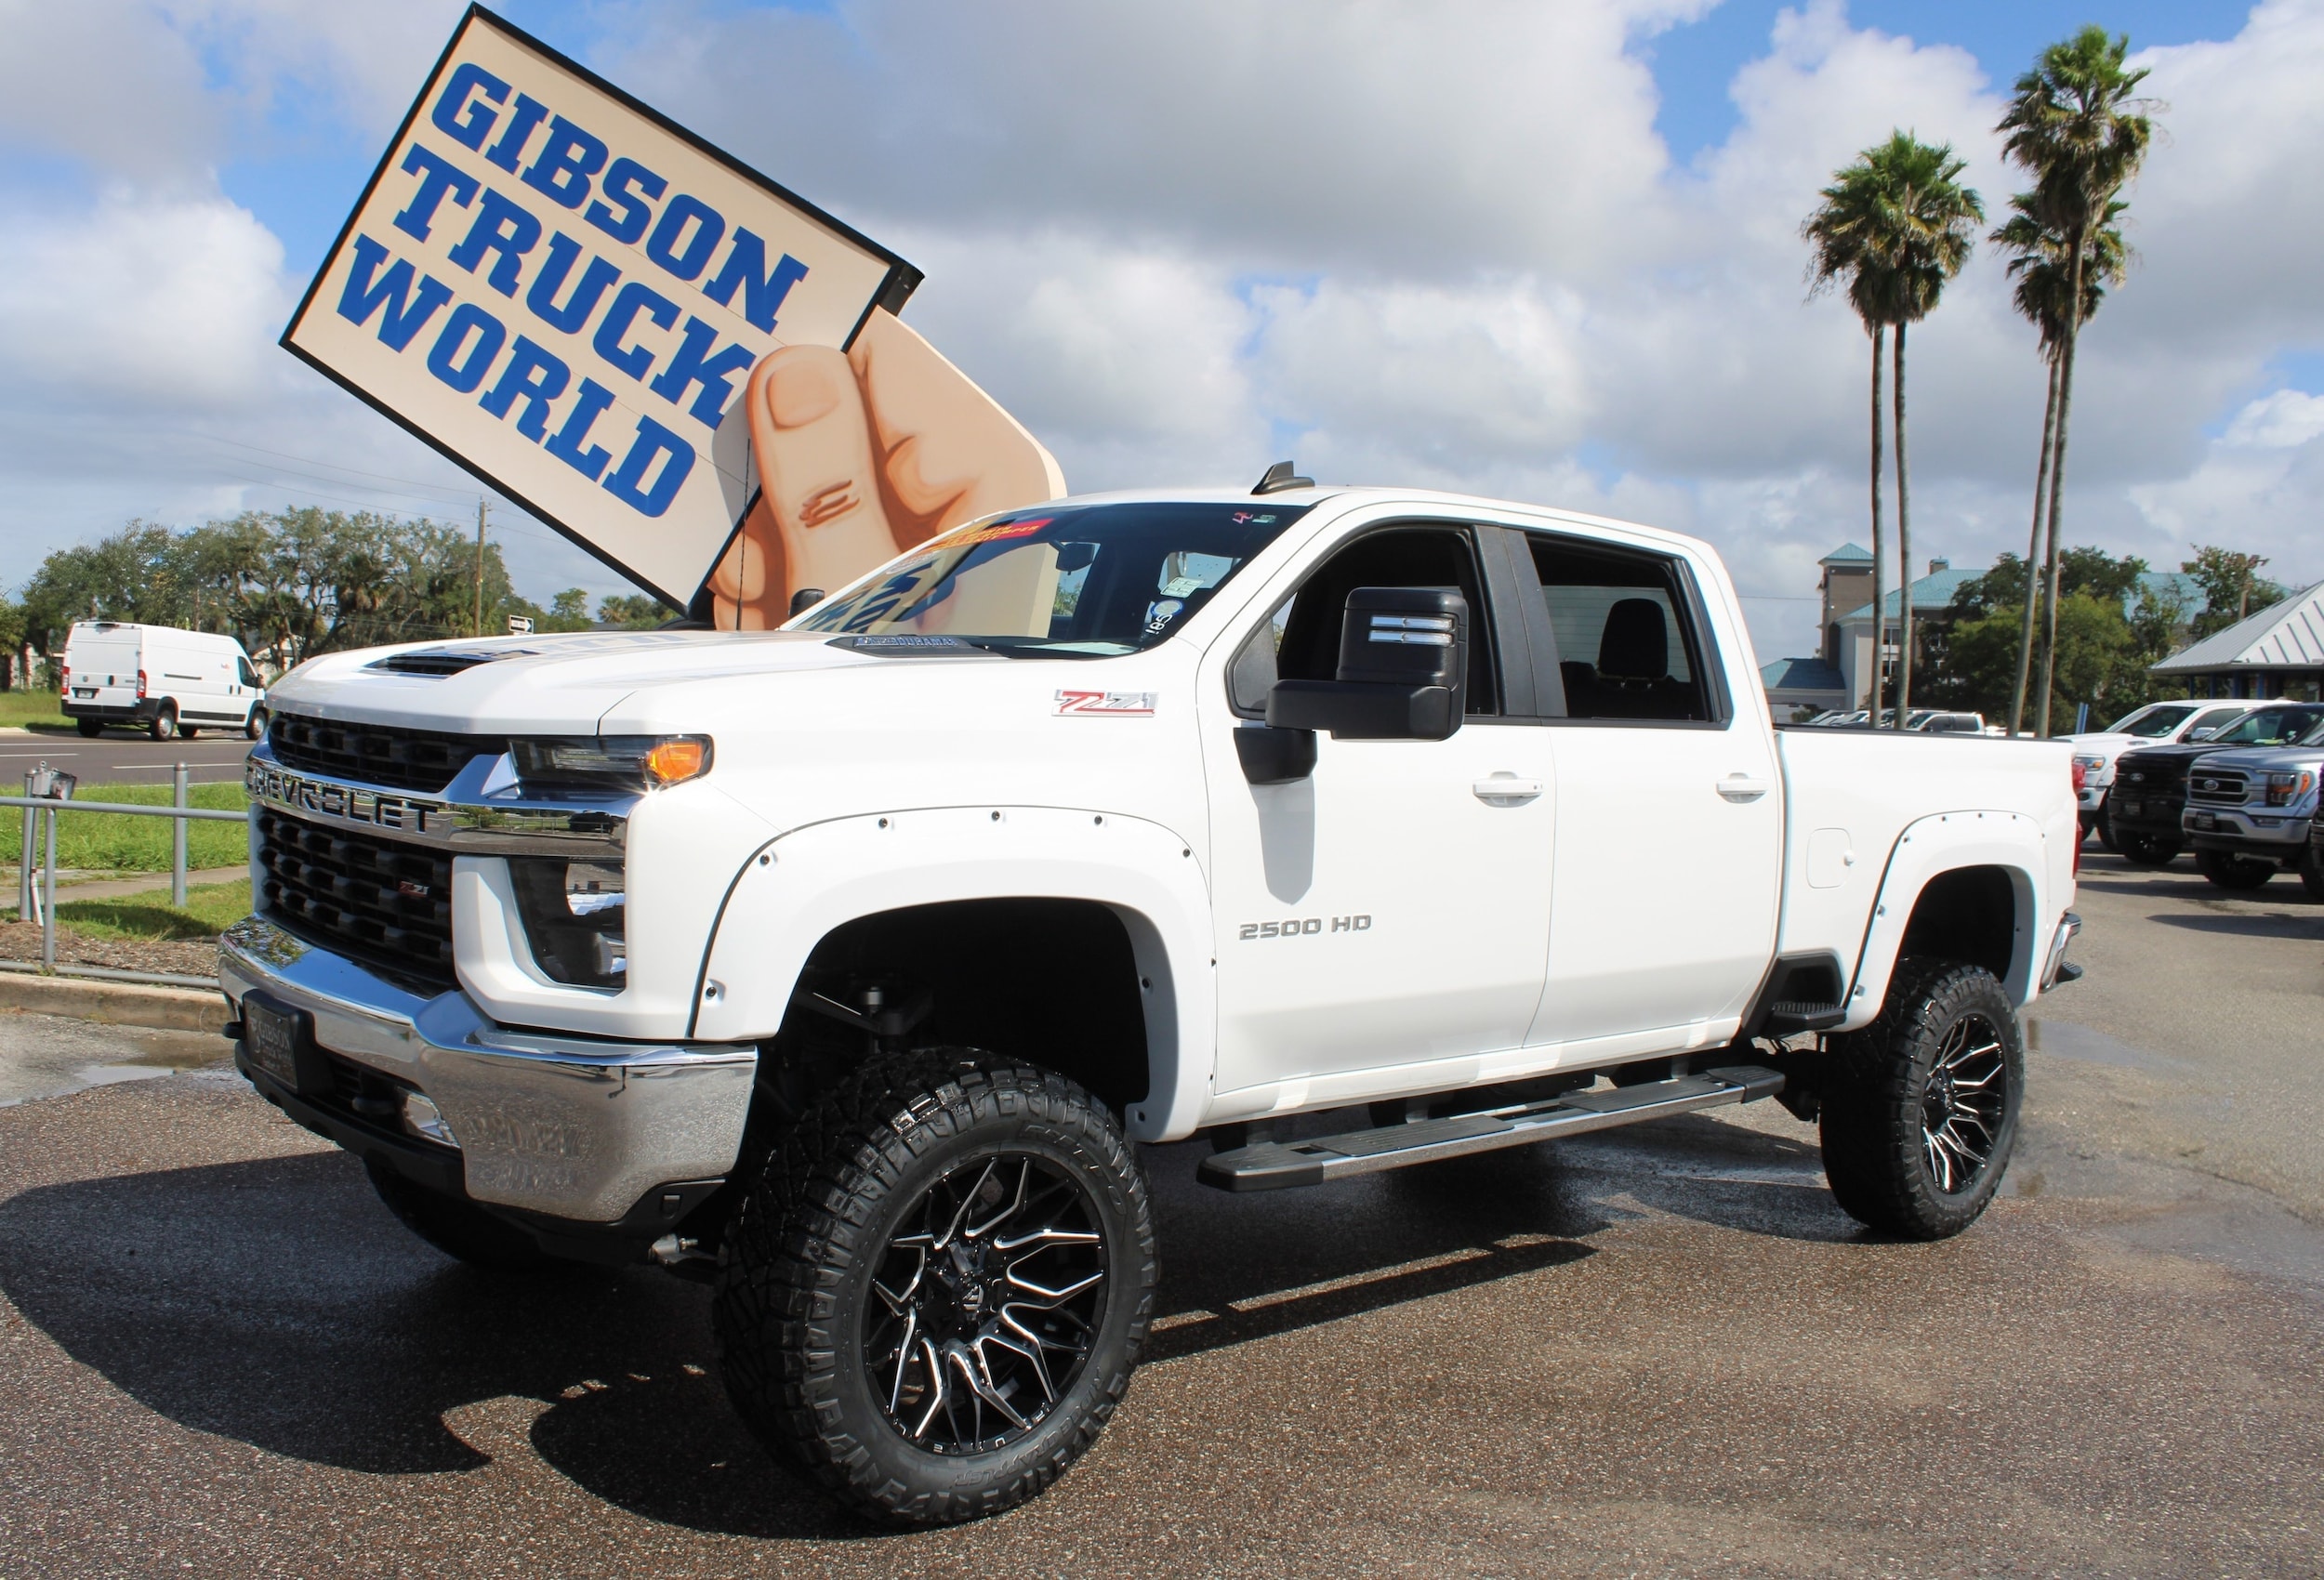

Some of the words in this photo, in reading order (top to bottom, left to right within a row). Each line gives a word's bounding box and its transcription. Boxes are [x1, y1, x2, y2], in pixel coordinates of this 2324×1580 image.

[392, 142, 757, 431] TRUCK
[431, 63, 810, 335] GIBSON
[337, 233, 694, 517] WORLD
[245, 764, 440, 835] CHEVROLET
[1239, 918, 1322, 941] 2500
[1331, 915, 1372, 932] HD
